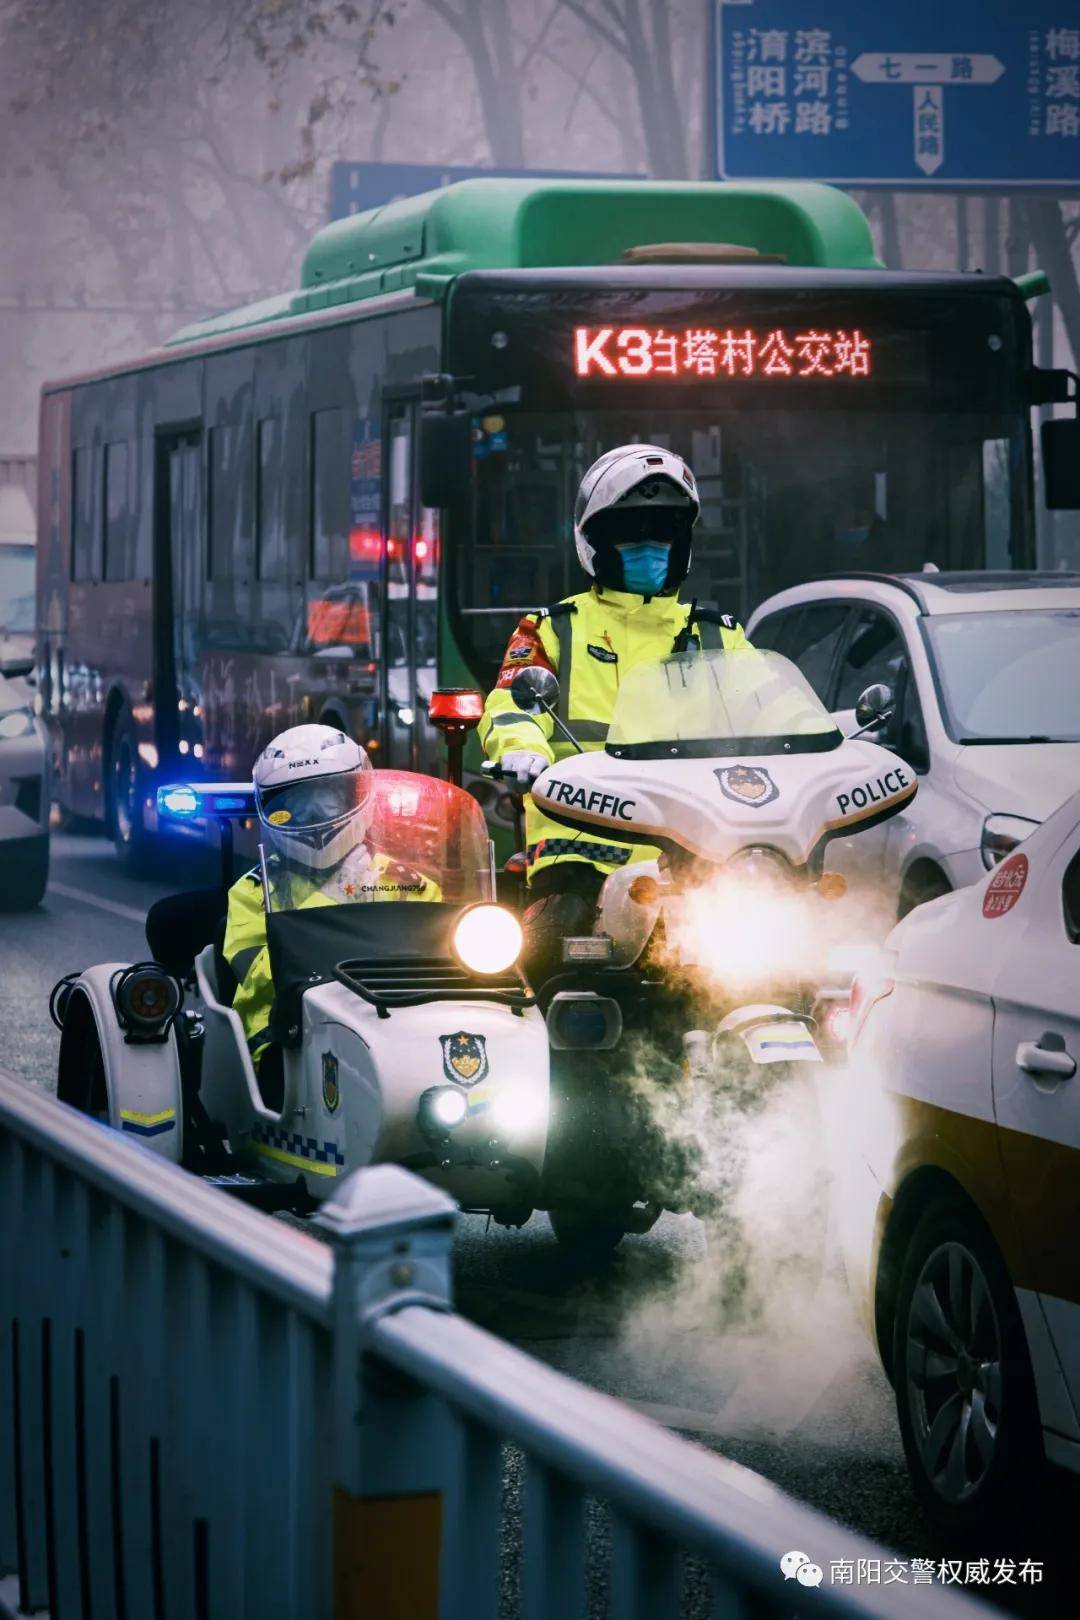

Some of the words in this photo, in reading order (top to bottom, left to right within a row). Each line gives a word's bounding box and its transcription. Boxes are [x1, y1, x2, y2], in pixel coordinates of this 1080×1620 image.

[794, 28, 832, 135] 滨河路
[879, 56, 974, 79] 七一路
[1045, 27, 1080, 137] 梅溪路
[545, 779, 637, 821] TRAFFIC
[836, 767, 910, 816] POLICE
